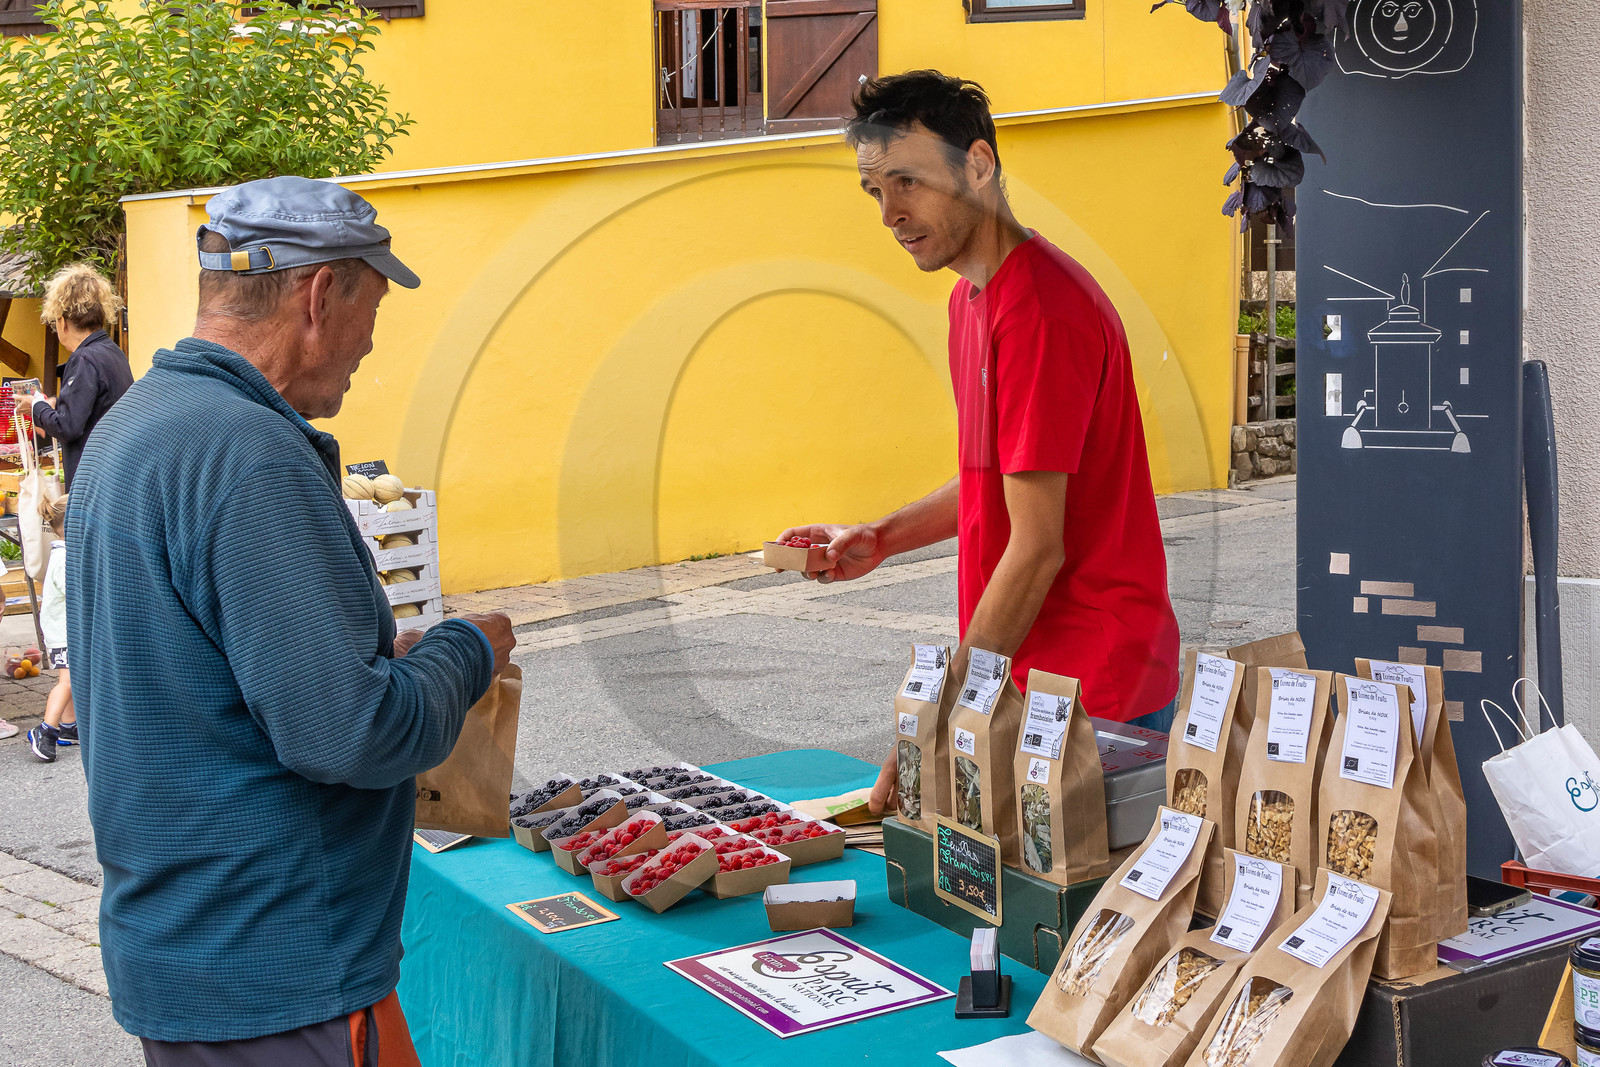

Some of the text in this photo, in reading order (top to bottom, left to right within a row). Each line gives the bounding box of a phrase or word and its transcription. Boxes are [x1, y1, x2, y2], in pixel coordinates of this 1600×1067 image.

[752, 951, 895, 995] Esprit
[789, 983, 834, 1010] NATIONAL
[802, 978, 857, 1005] PARC
